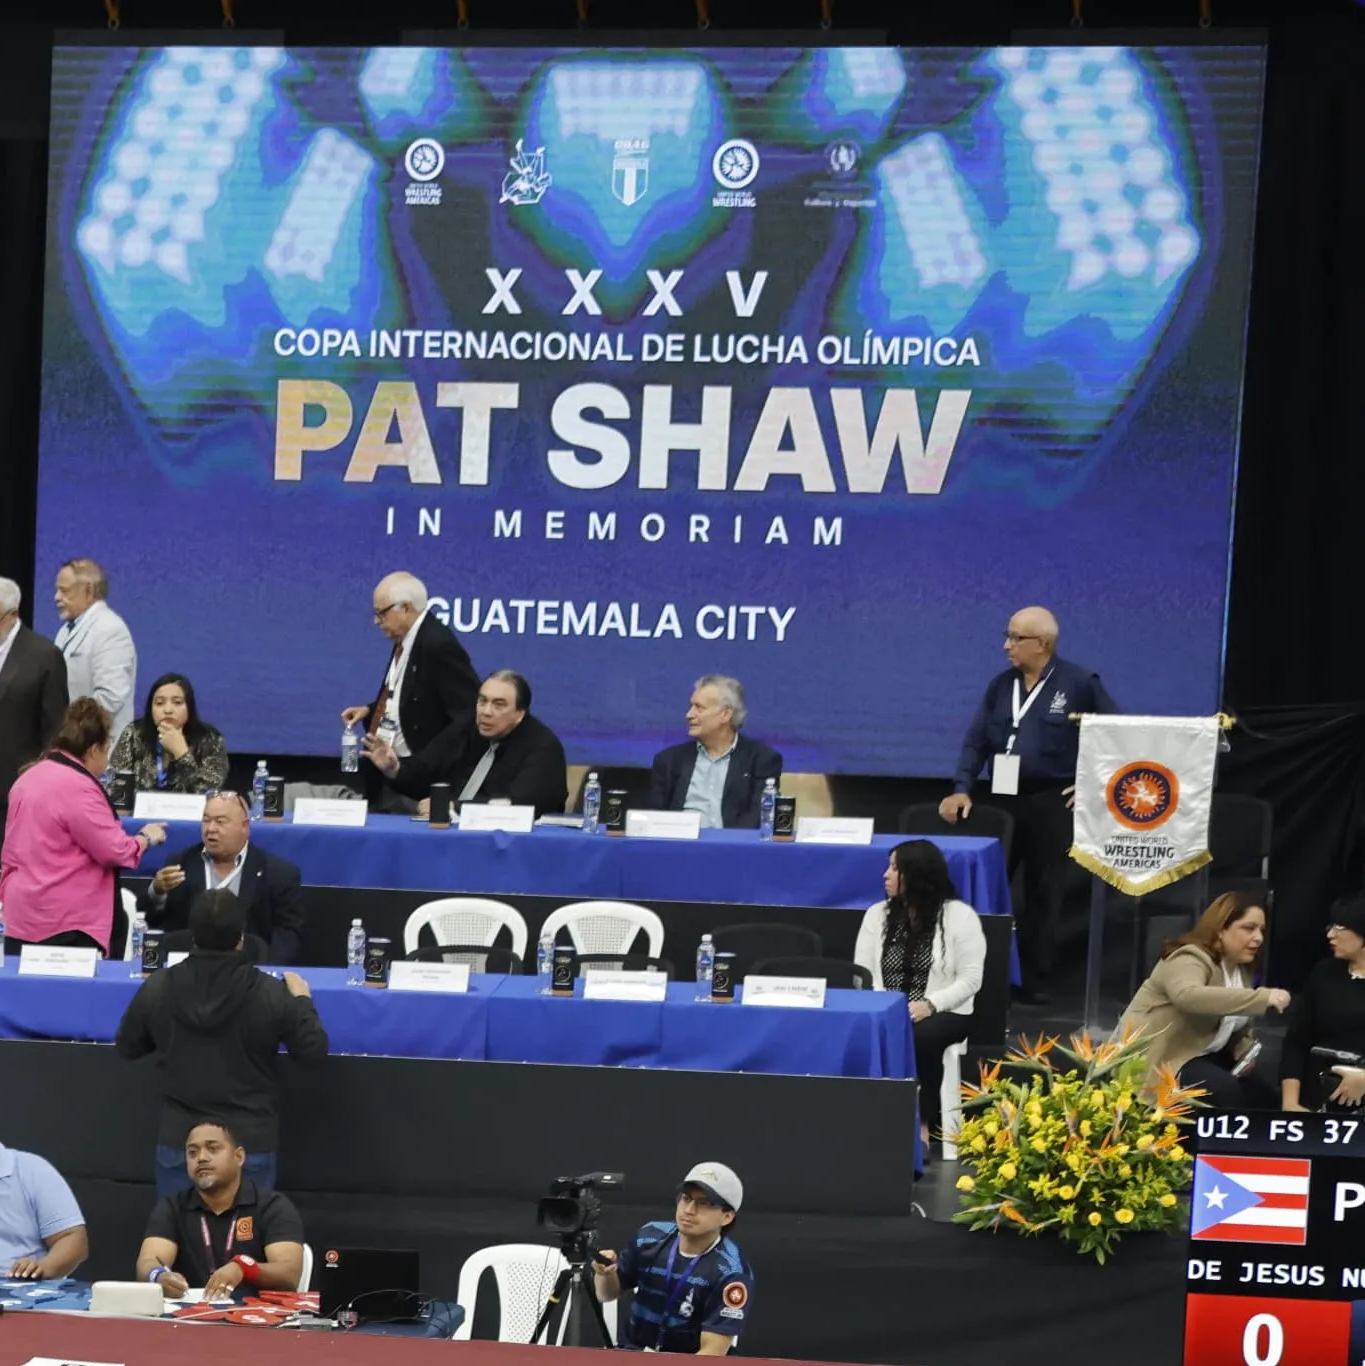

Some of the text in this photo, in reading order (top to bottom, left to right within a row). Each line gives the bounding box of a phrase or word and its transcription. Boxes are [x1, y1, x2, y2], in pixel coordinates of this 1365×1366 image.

[273, 327, 980, 367] COPA INTERNACIONAL DE LUCHA OLÍMPICA
[273, 378, 972, 495] PAT SHAW
[386, 506, 843, 546] IN MEMORIAM
[426, 597, 796, 642] GUATEMALA CITY
[1104, 845, 1175, 859] WRESTLING
[1112, 835, 1168, 845] UNITED WORLD
[1113, 859, 1161, 869] AMERICAS
[1197, 1115, 1359, 1144] U12 FS 37
[1187, 1259, 1222, 1280] DE
[1239, 1262, 1325, 1286] JESUS
